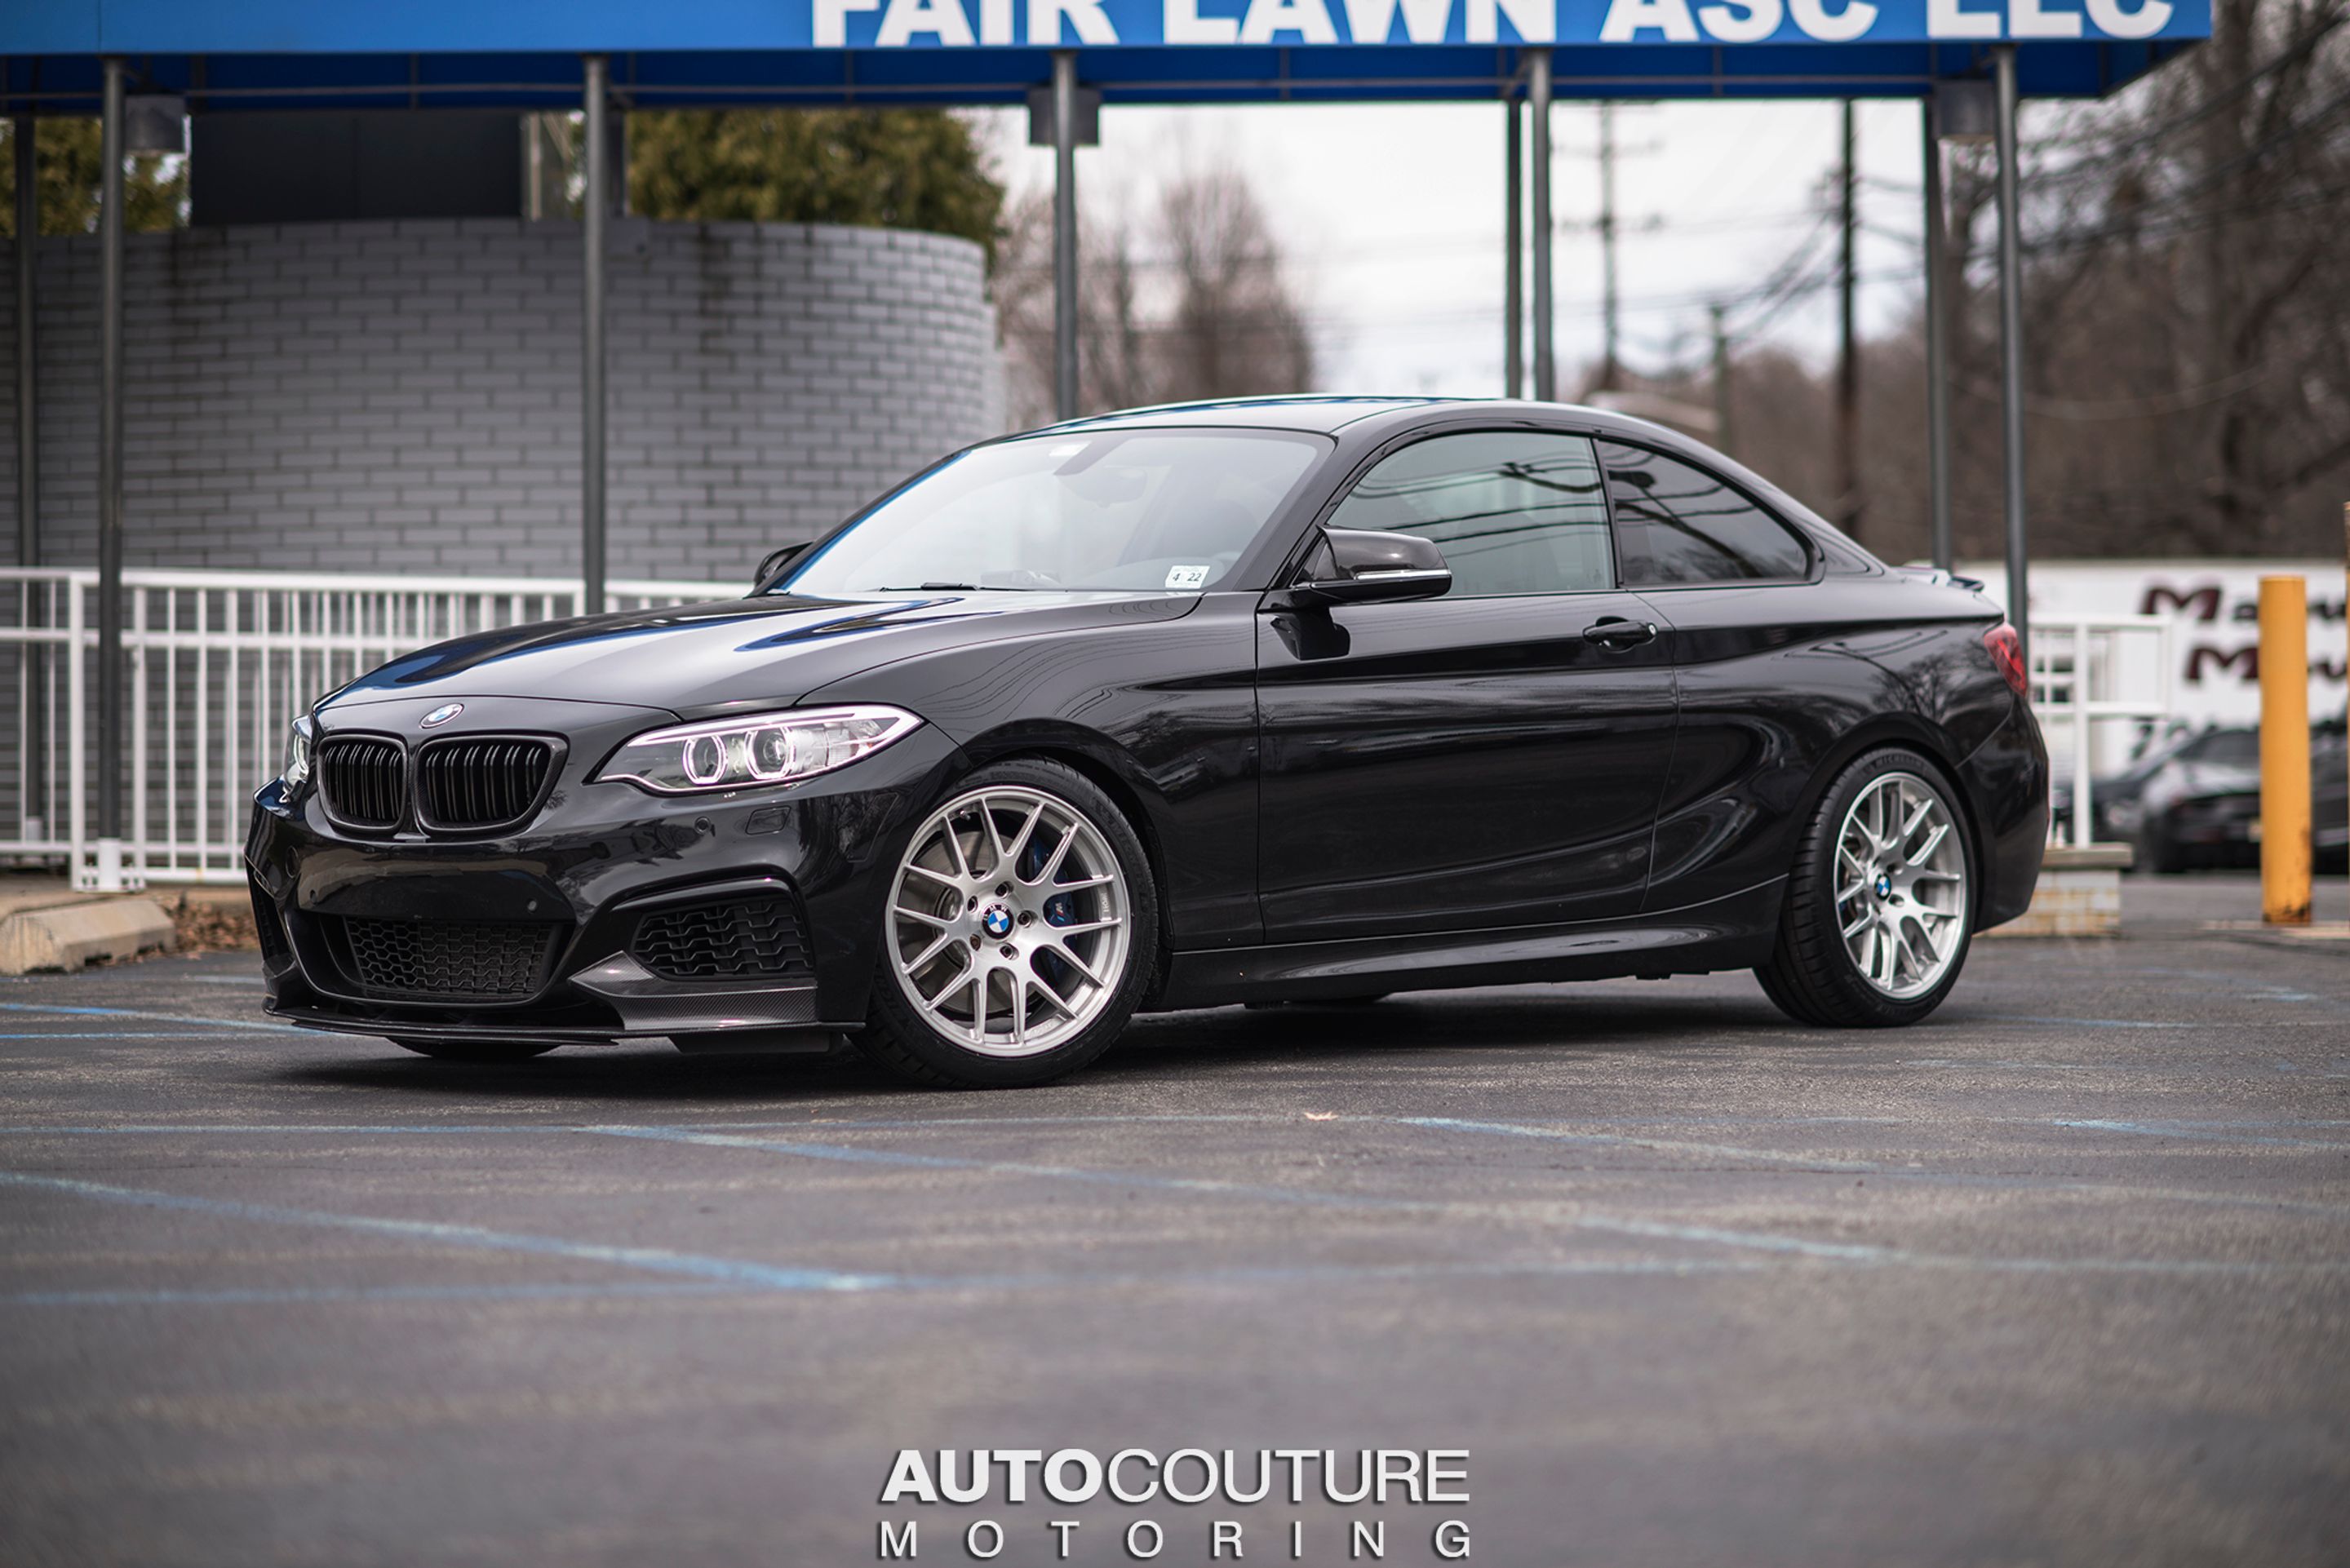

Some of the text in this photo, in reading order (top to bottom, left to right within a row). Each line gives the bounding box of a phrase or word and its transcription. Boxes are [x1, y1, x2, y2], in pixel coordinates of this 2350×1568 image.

[812, 0, 1120, 47] FAIR
[1164, 0, 1557, 45] LAWN
[1598, 0, 1878, 42] ASC
[1172, 573, 1203, 582] 4 22
